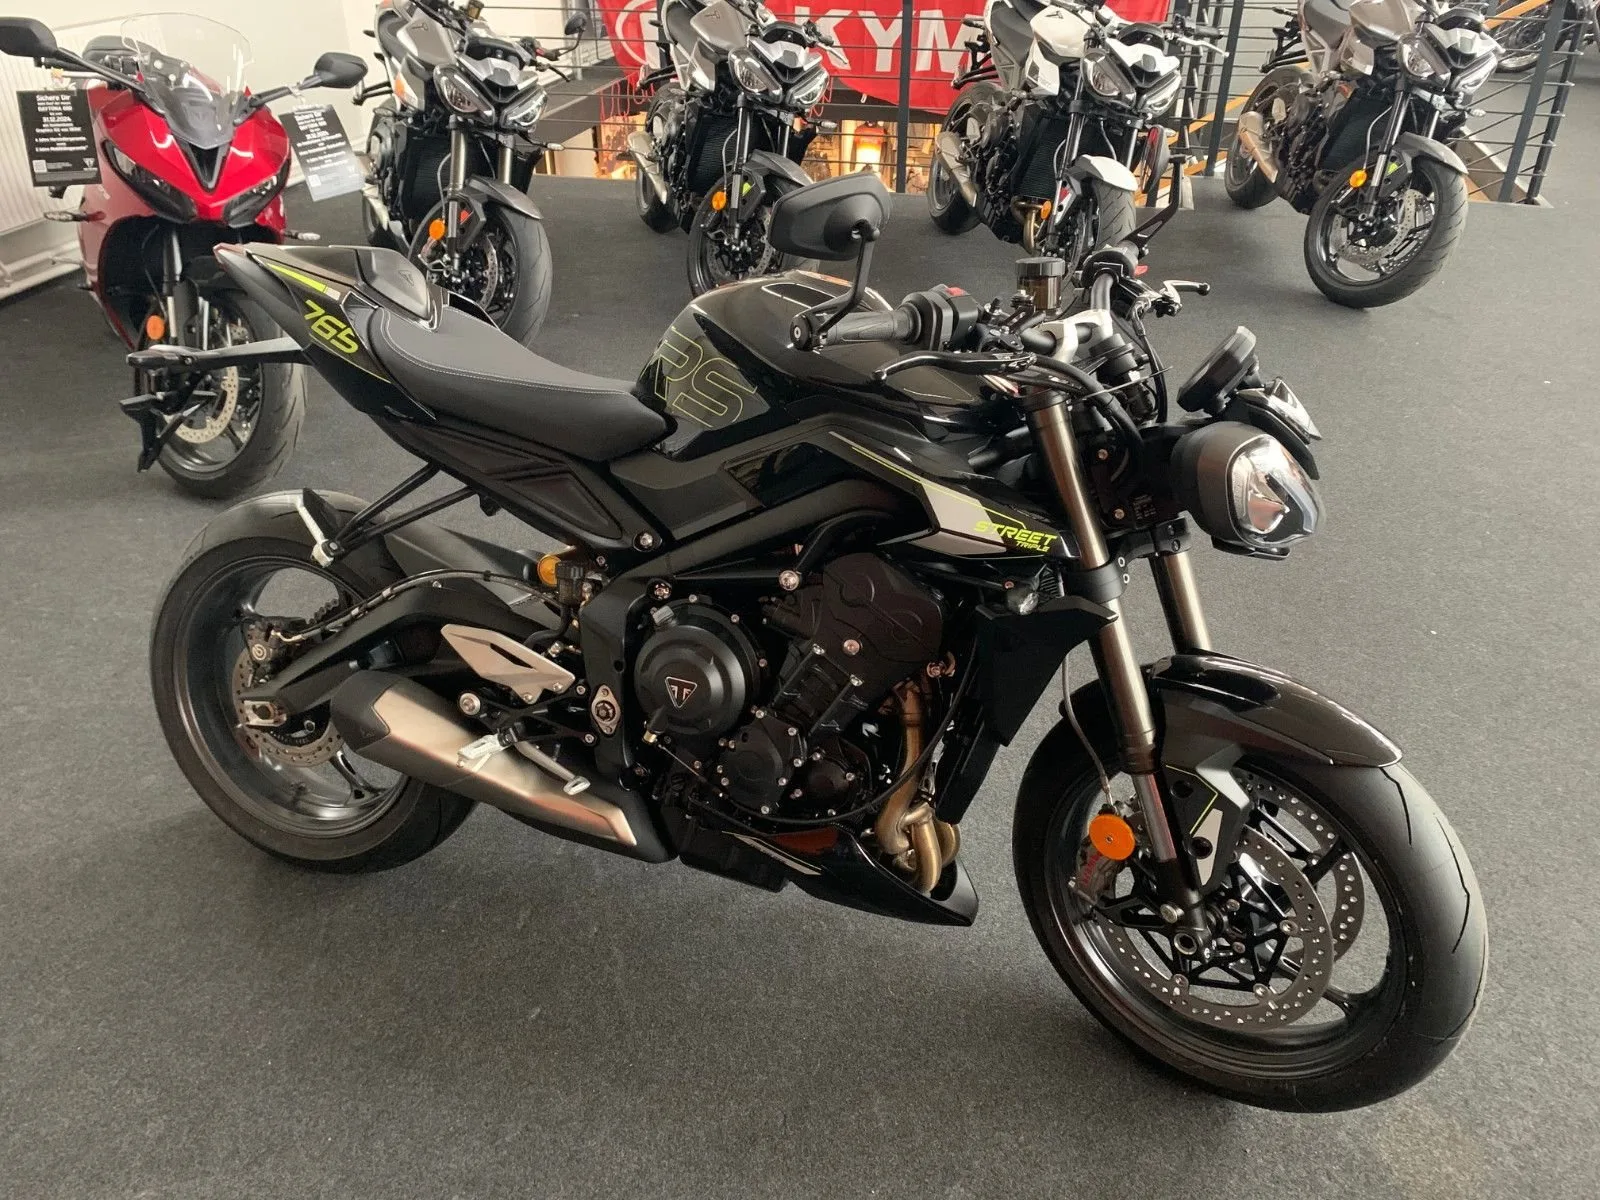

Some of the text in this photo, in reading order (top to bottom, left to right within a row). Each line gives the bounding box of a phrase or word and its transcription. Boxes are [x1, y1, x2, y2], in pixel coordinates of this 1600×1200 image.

[303, 299, 359, 353] 765
[655, 325, 758, 428] RS
[974, 521, 1058, 546] STREET
[1015, 541, 1051, 553] TRIPLE
